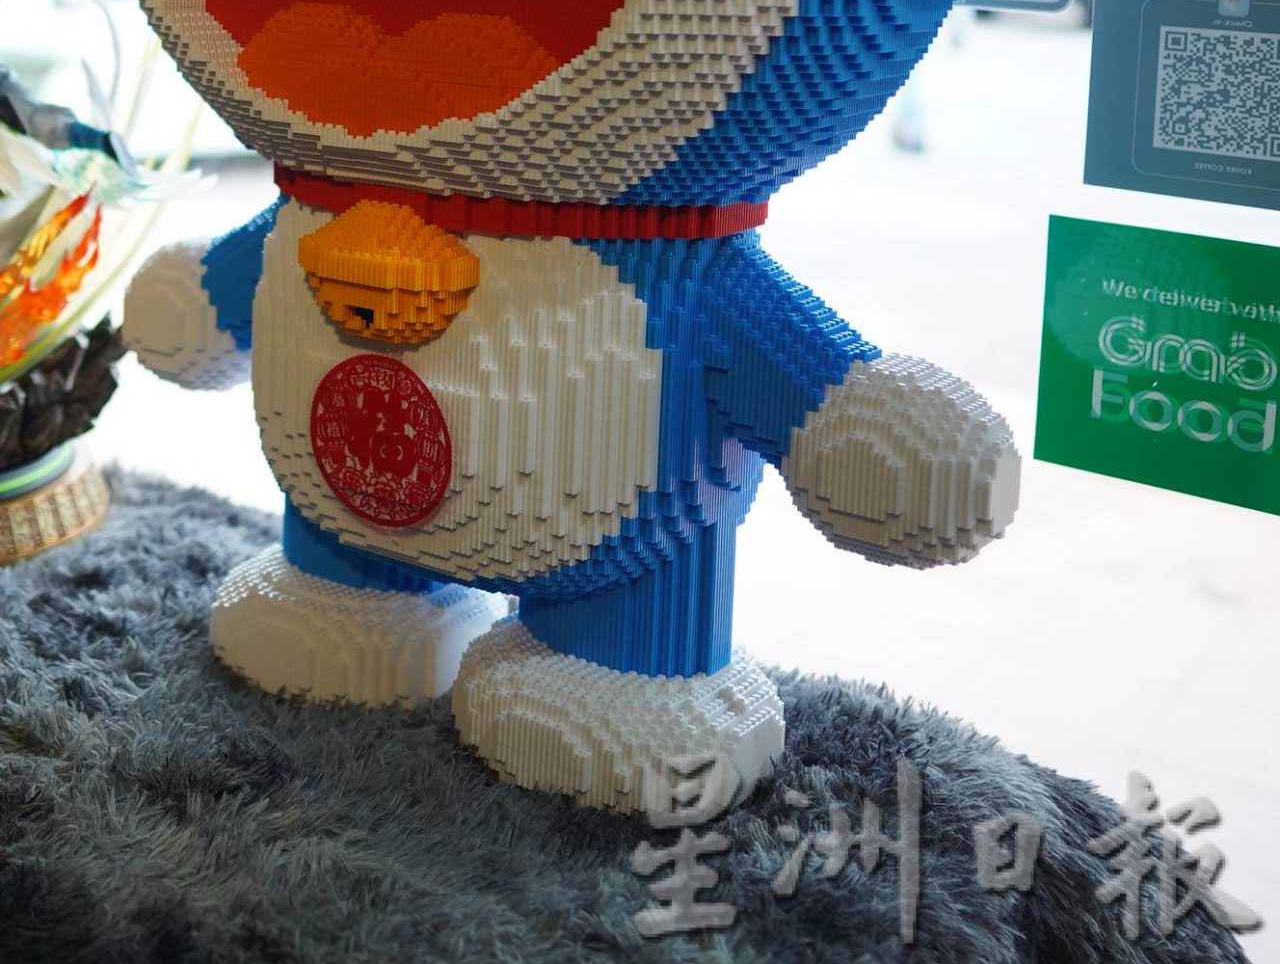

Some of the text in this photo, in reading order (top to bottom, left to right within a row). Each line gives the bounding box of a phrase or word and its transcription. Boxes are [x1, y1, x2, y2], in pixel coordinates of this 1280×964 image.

[1103, 279, 1138, 300] We
[1143, 286, 1221, 313] deliver
[1098, 315, 1278, 391] Grab
